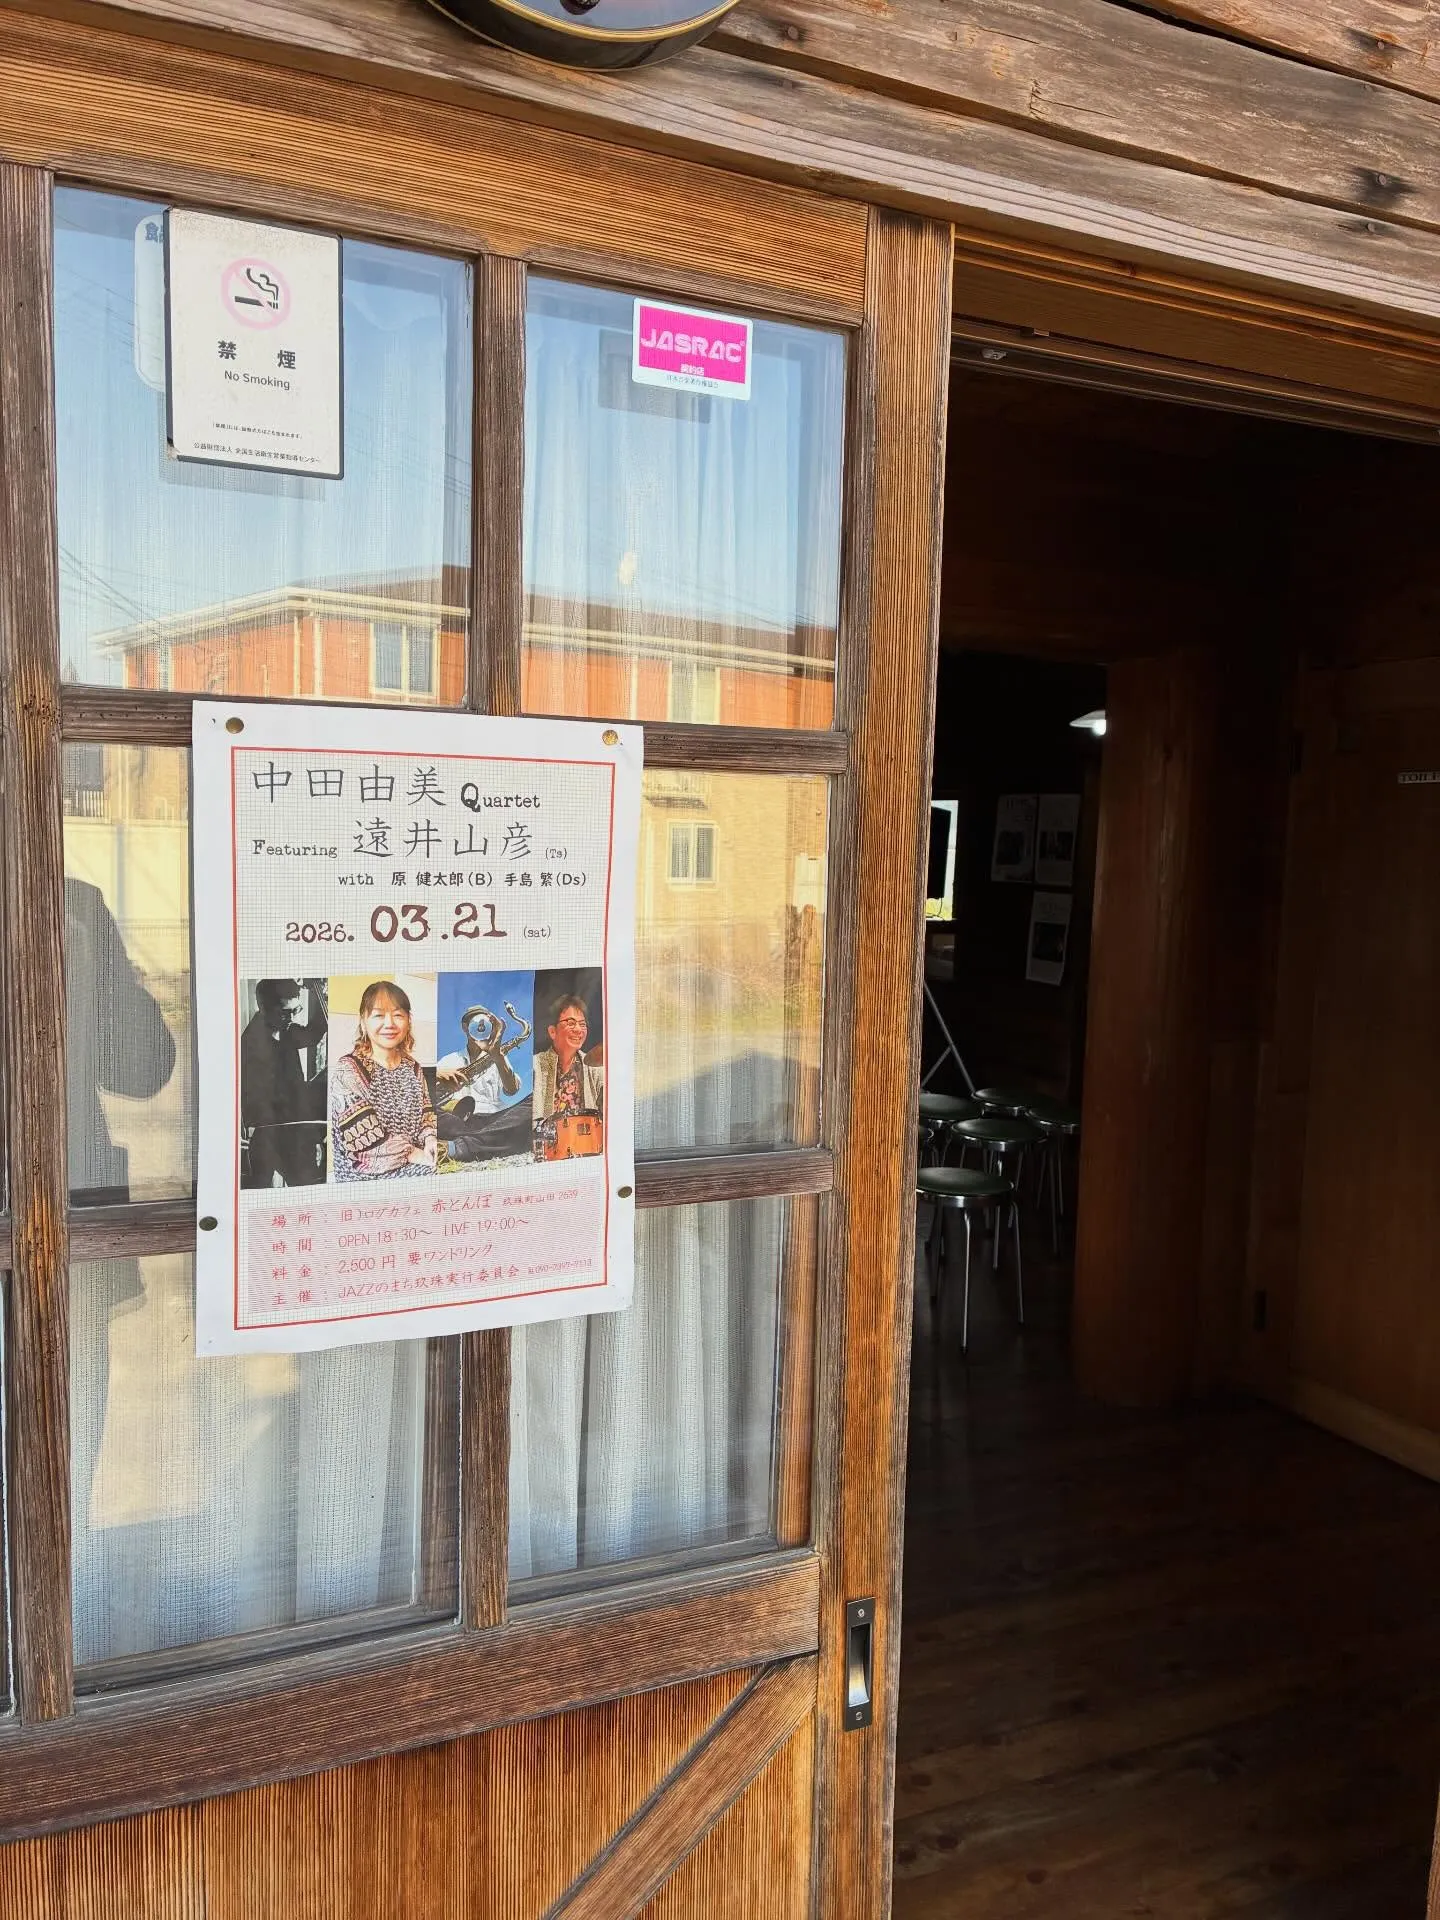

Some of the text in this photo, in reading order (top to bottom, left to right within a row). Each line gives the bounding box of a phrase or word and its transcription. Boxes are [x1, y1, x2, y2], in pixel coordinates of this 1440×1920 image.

[640, 328, 742, 363] JASRAC
[224, 370, 290, 390] No Smoking
[252, 761, 541, 812] 中田由美 Quartet
[252, 839, 338, 858] Featuring
[353, 816, 532, 860] 遠井山彦
[338, 873, 374, 886] with
[391, 871, 406, 886] 原
[504, 873, 533, 887] 手島
[286, 902, 551, 943] 2026. 03.21 (sat)
[432, 1194, 492, 1213] 赤とんぼ
[338, 1234, 370, 1248] OPEN
[444, 1222, 470, 1237] LIVE
[382, 1254, 396, 1269] 円
